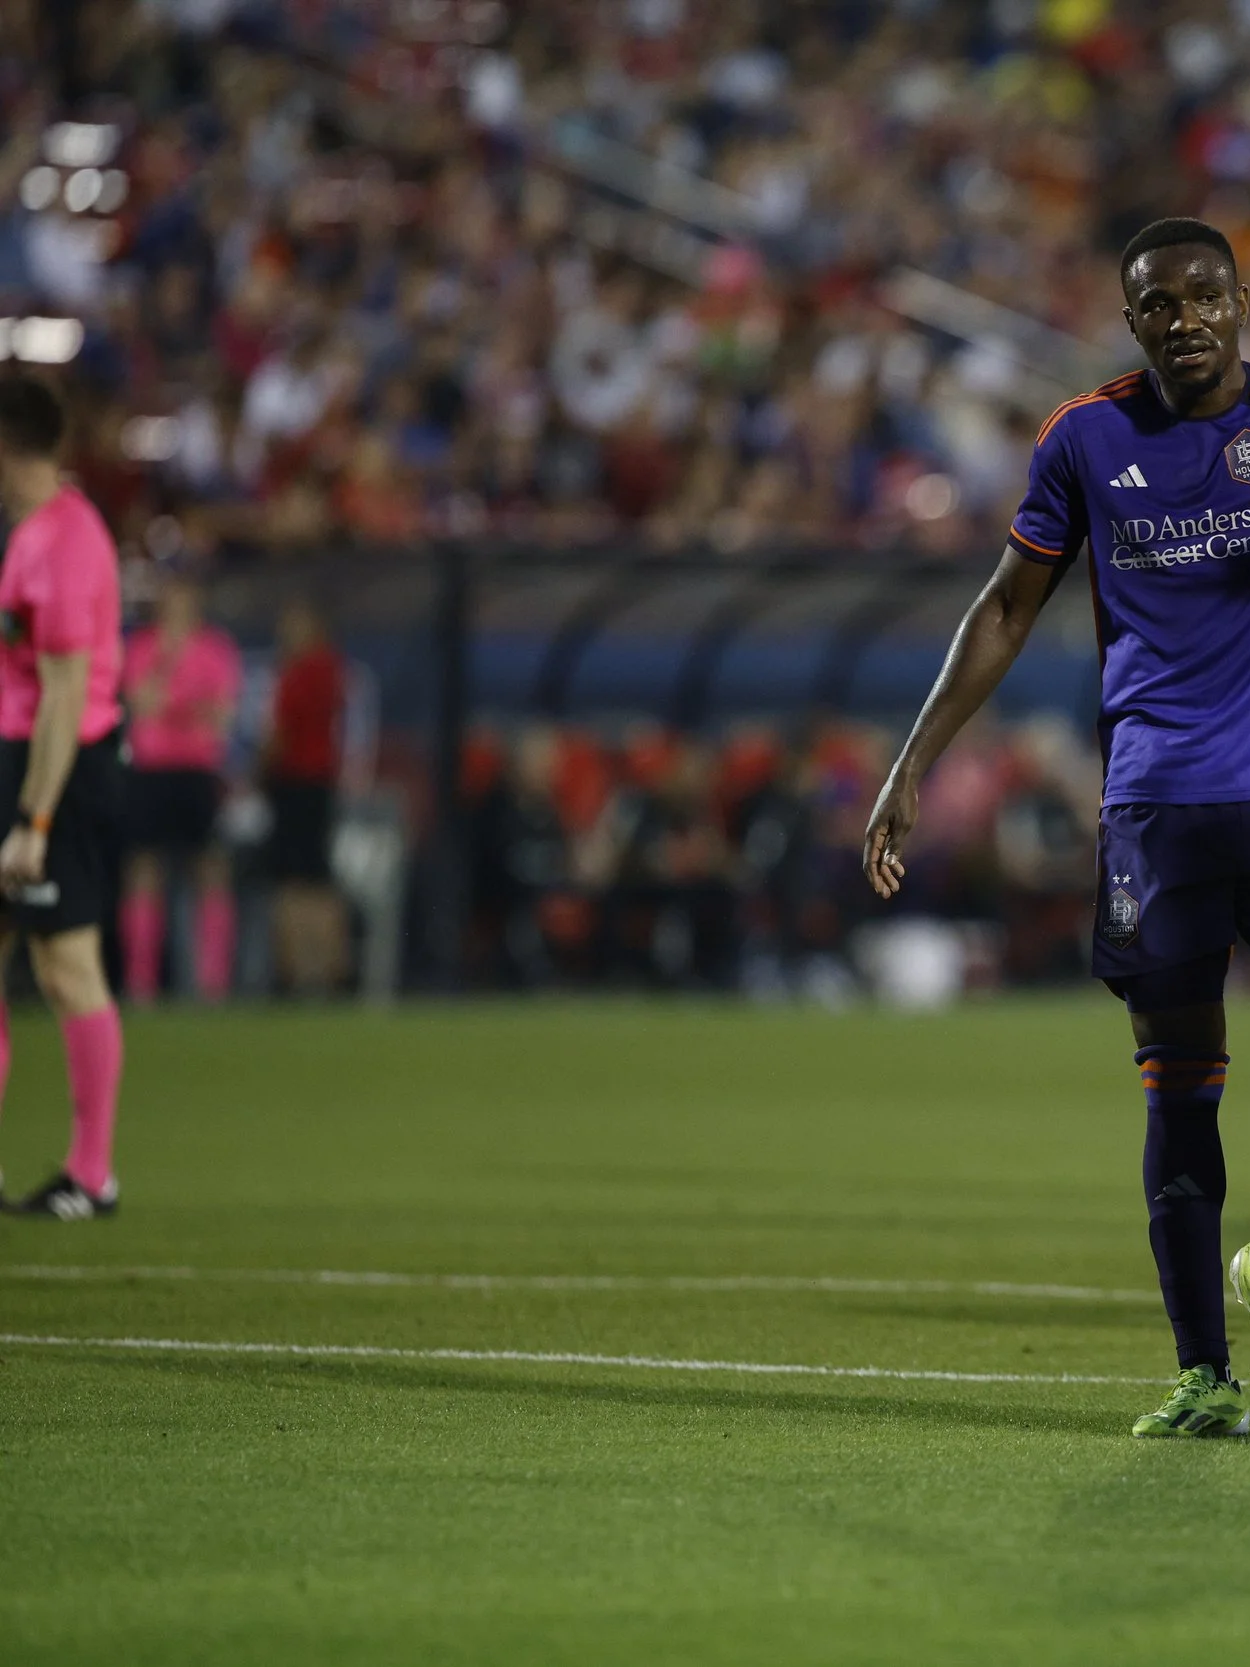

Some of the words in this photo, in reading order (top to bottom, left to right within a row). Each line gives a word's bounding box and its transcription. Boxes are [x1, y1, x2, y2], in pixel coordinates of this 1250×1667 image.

[1110, 519, 1155, 544] MD
[1110, 543, 1205, 571] Cancer
[1103, 925, 1135, 933] HOUSTON
